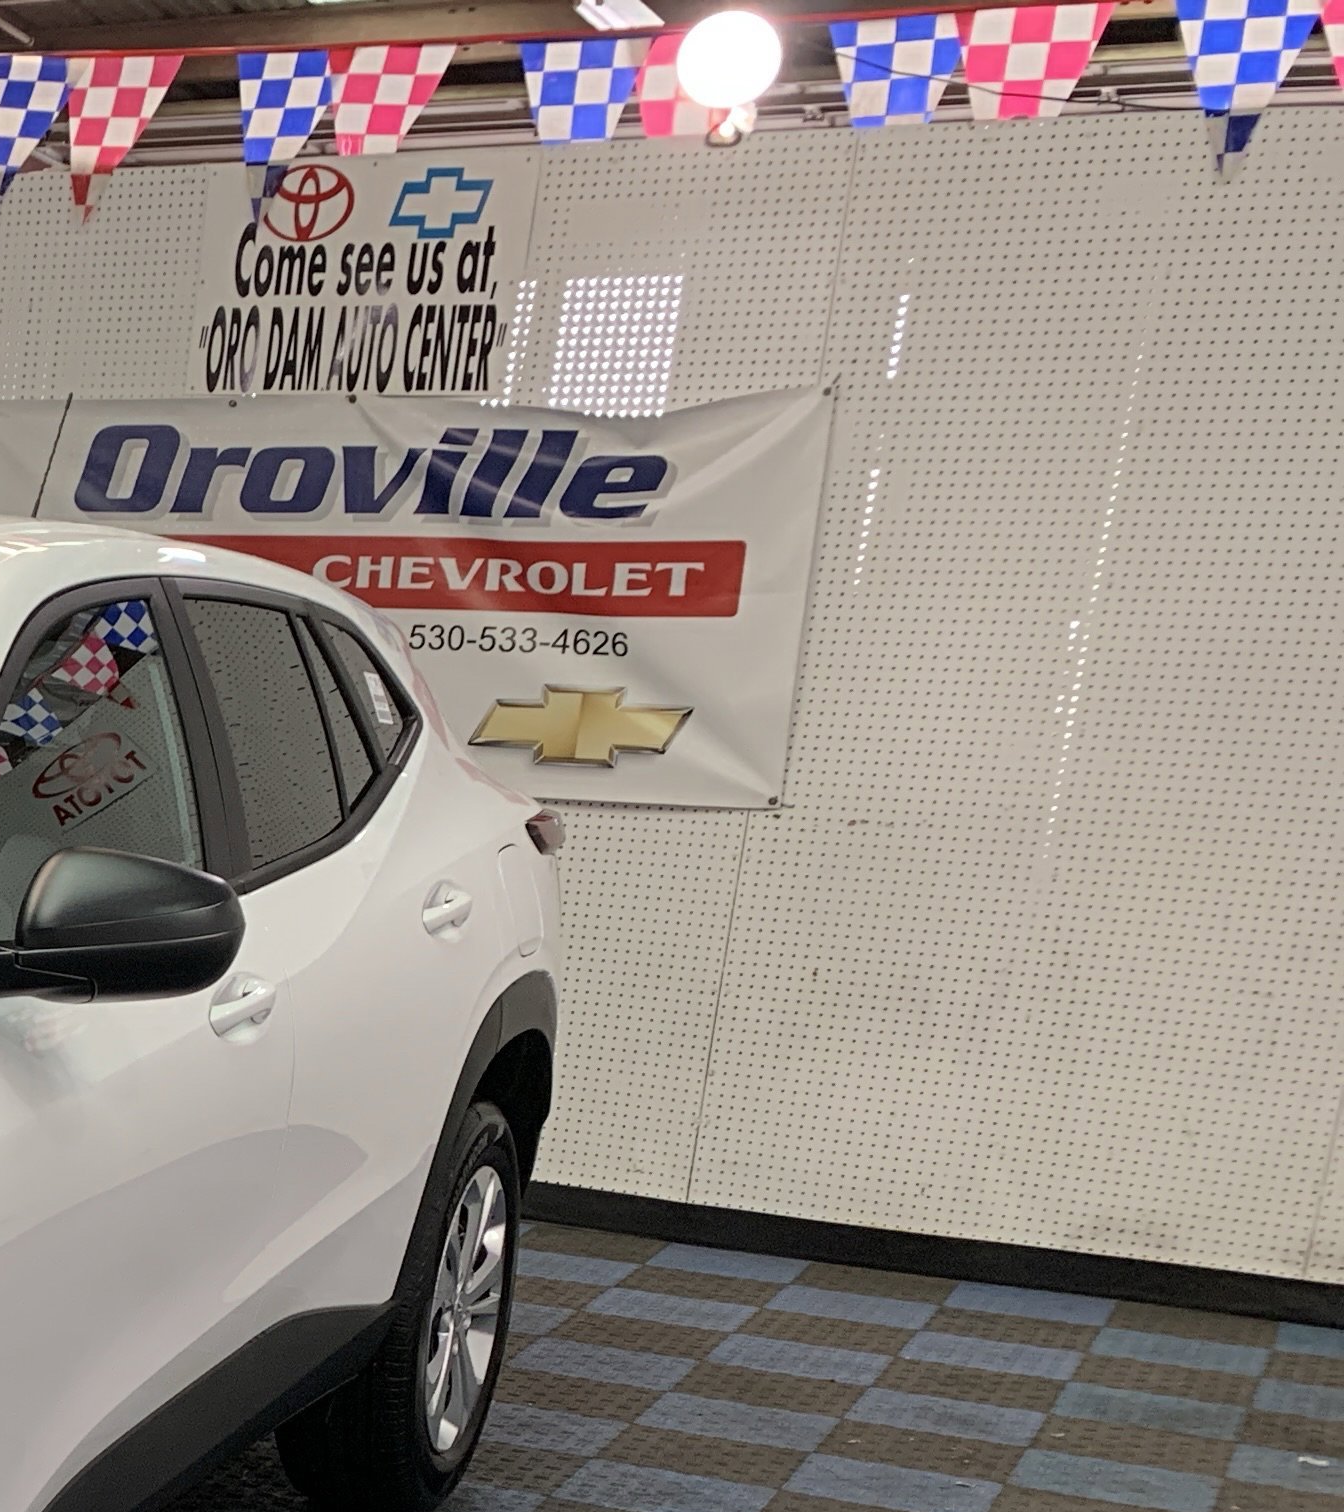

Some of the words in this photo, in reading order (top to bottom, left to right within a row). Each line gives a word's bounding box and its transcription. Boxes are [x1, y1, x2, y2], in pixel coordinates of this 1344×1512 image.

[235, 222, 327, 298] Come
[336, 242, 396, 296] see
[407, 241, 447, 295] us
[457, 226, 497, 299] at,
[263, 306, 325, 391] DAM
[327, 303, 398, 393] AUTO
[403, 303, 507, 393] CENTER"
[75, 424, 669, 520] Oroville
[313, 553, 706, 598] CHEVROLET
[408, 625, 630, 657] 530-533-4626
